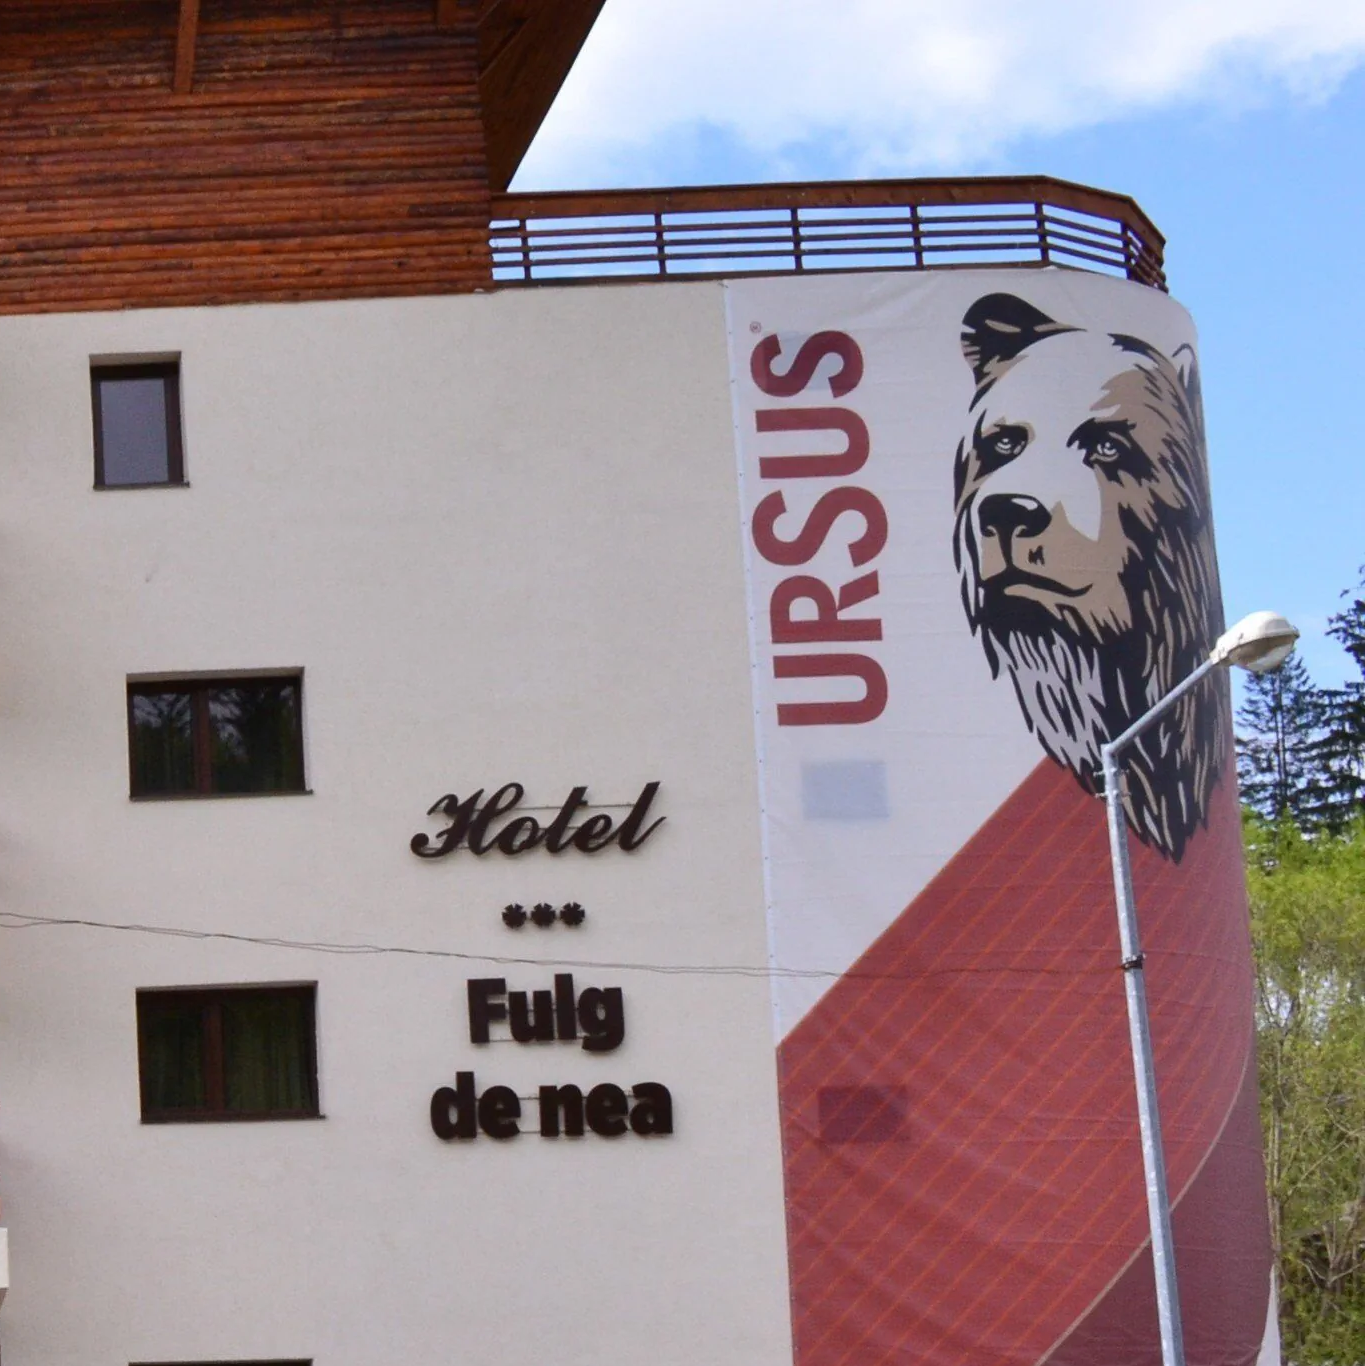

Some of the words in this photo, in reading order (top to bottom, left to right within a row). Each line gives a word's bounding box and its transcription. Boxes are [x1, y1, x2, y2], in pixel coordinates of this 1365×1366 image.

[750, 329, 888, 727] URSUS
[410, 781, 667, 858] Hotel
[467, 973, 626, 1053] Fulg
[430, 1071, 521, 1140] de
[539, 1082, 673, 1138] nea
